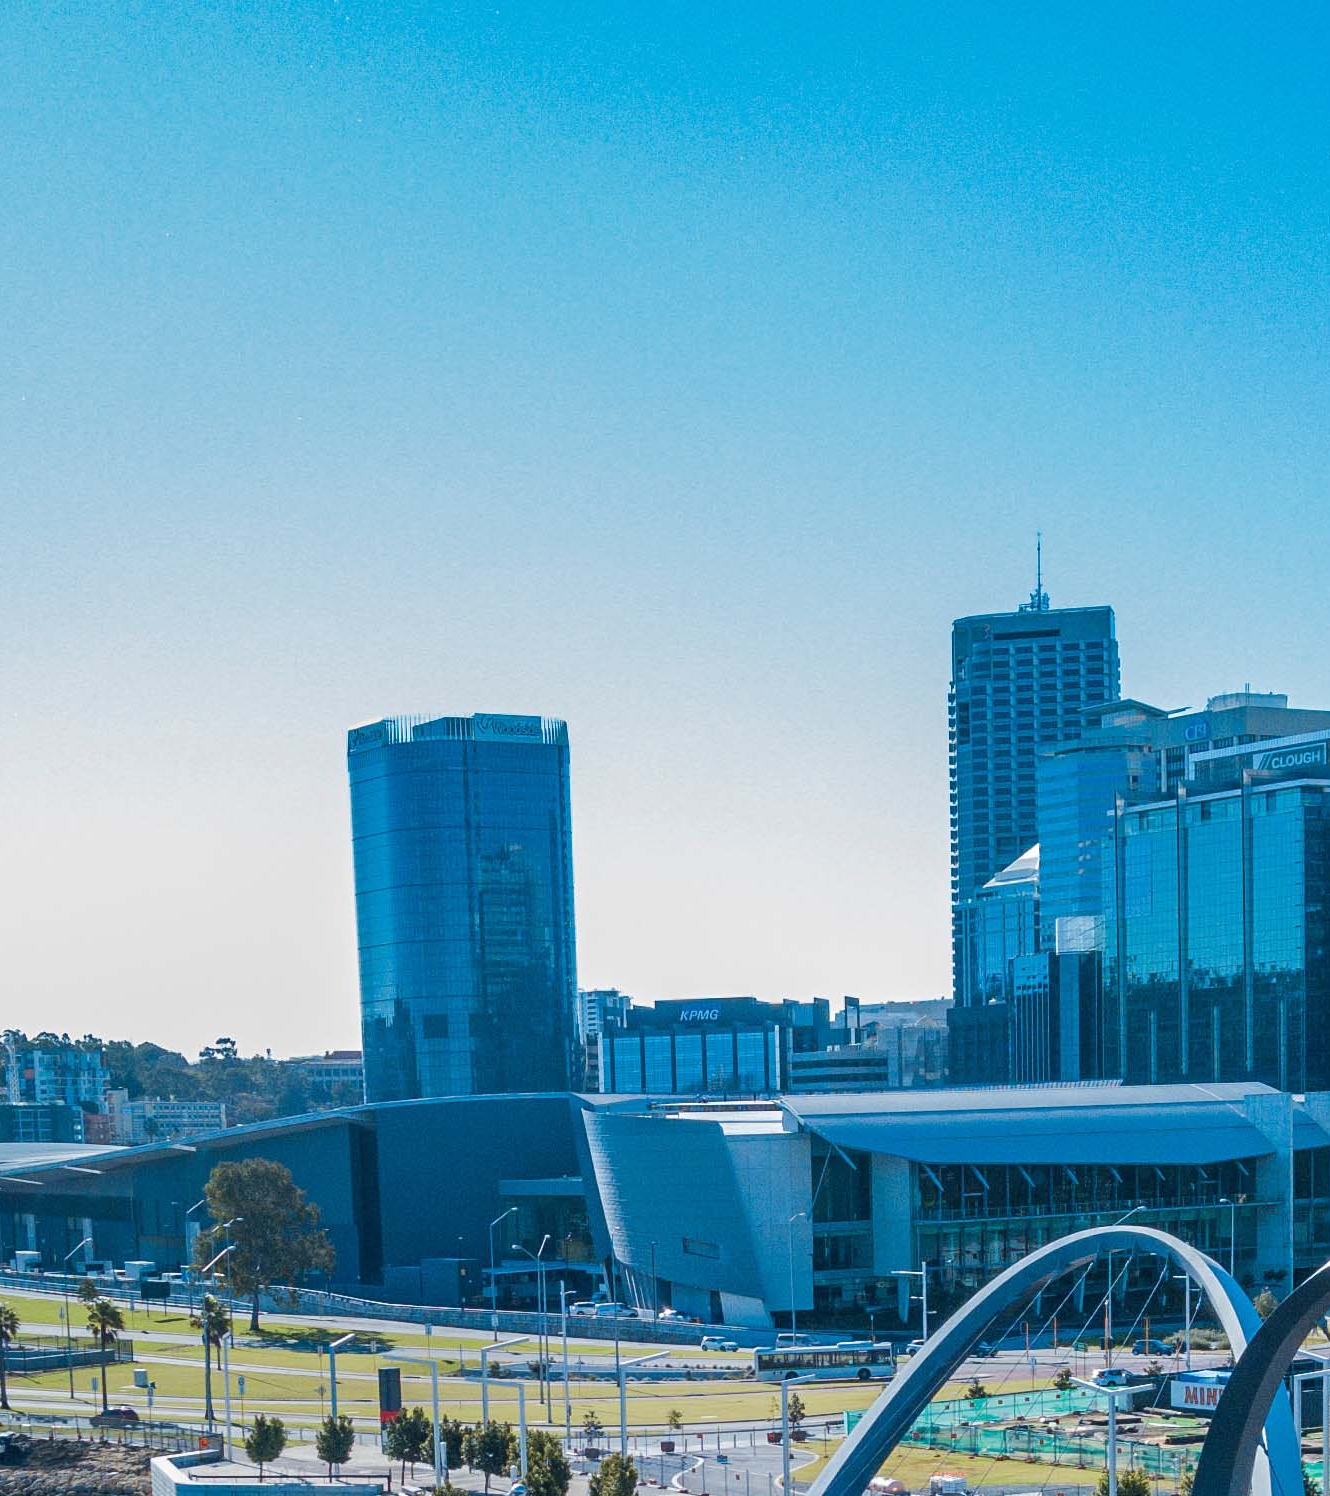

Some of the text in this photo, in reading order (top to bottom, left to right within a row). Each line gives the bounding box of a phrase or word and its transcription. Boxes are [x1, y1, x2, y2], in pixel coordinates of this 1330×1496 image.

[493, 718, 540, 735] Woodside
[1271, 752, 1320, 769] CLOUGH
[680, 1010, 719, 1021] KPMG
